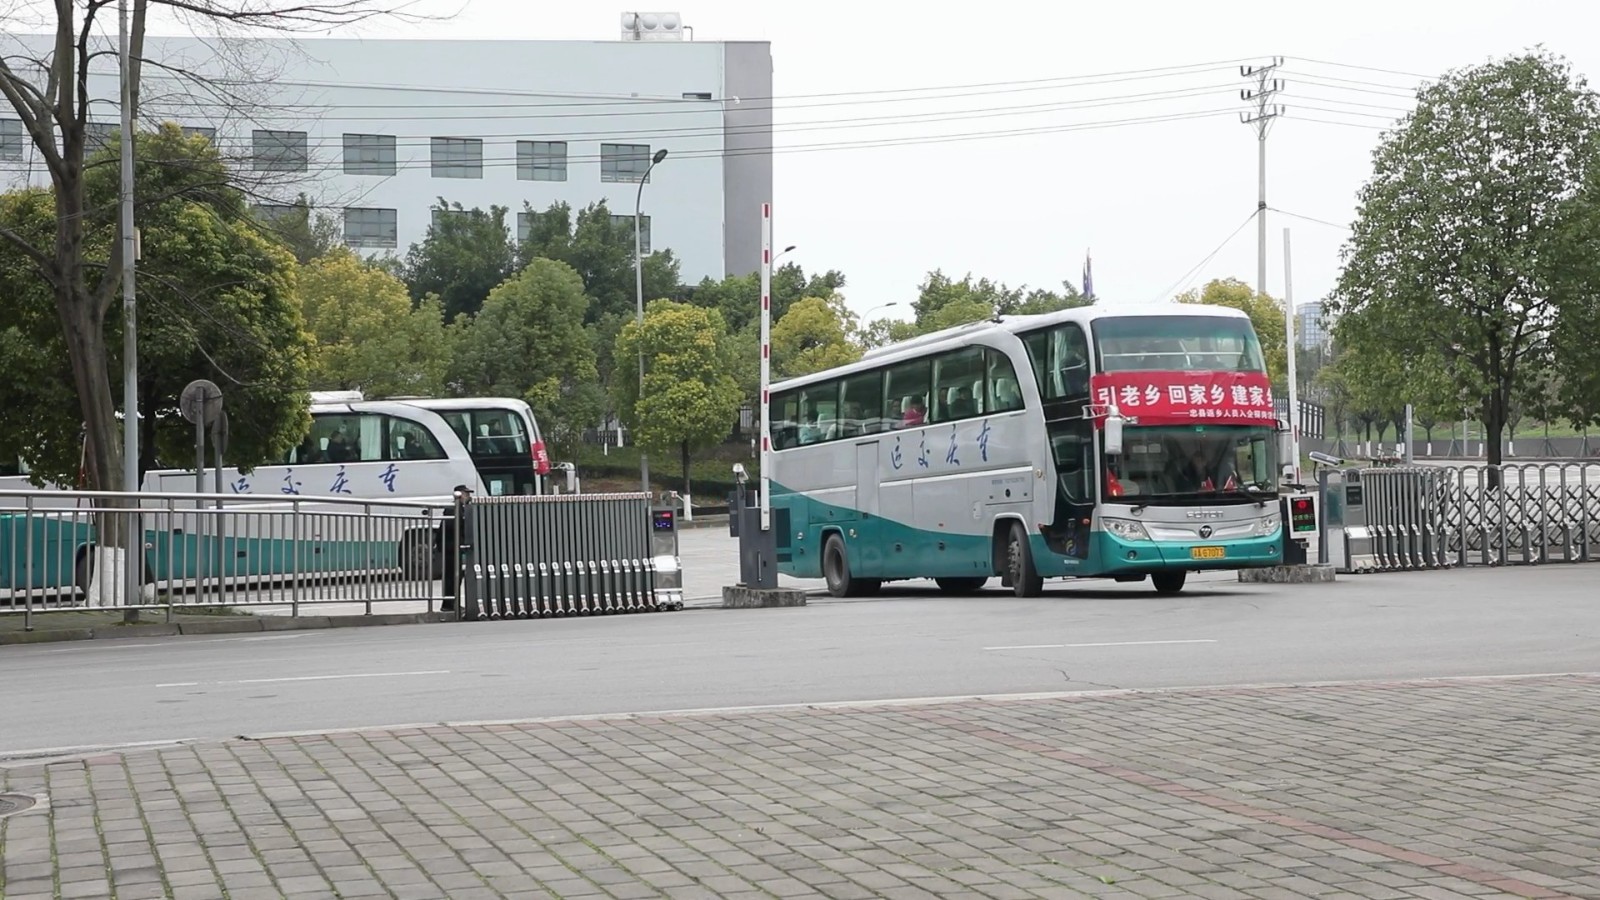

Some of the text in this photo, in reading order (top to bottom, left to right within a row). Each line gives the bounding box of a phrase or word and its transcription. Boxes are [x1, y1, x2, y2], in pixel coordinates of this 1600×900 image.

[1098, 385, 1161, 407] 引老乡
[1168, 384, 1225, 405] 回家乡
[1186, 510, 1224, 519] FOTON
